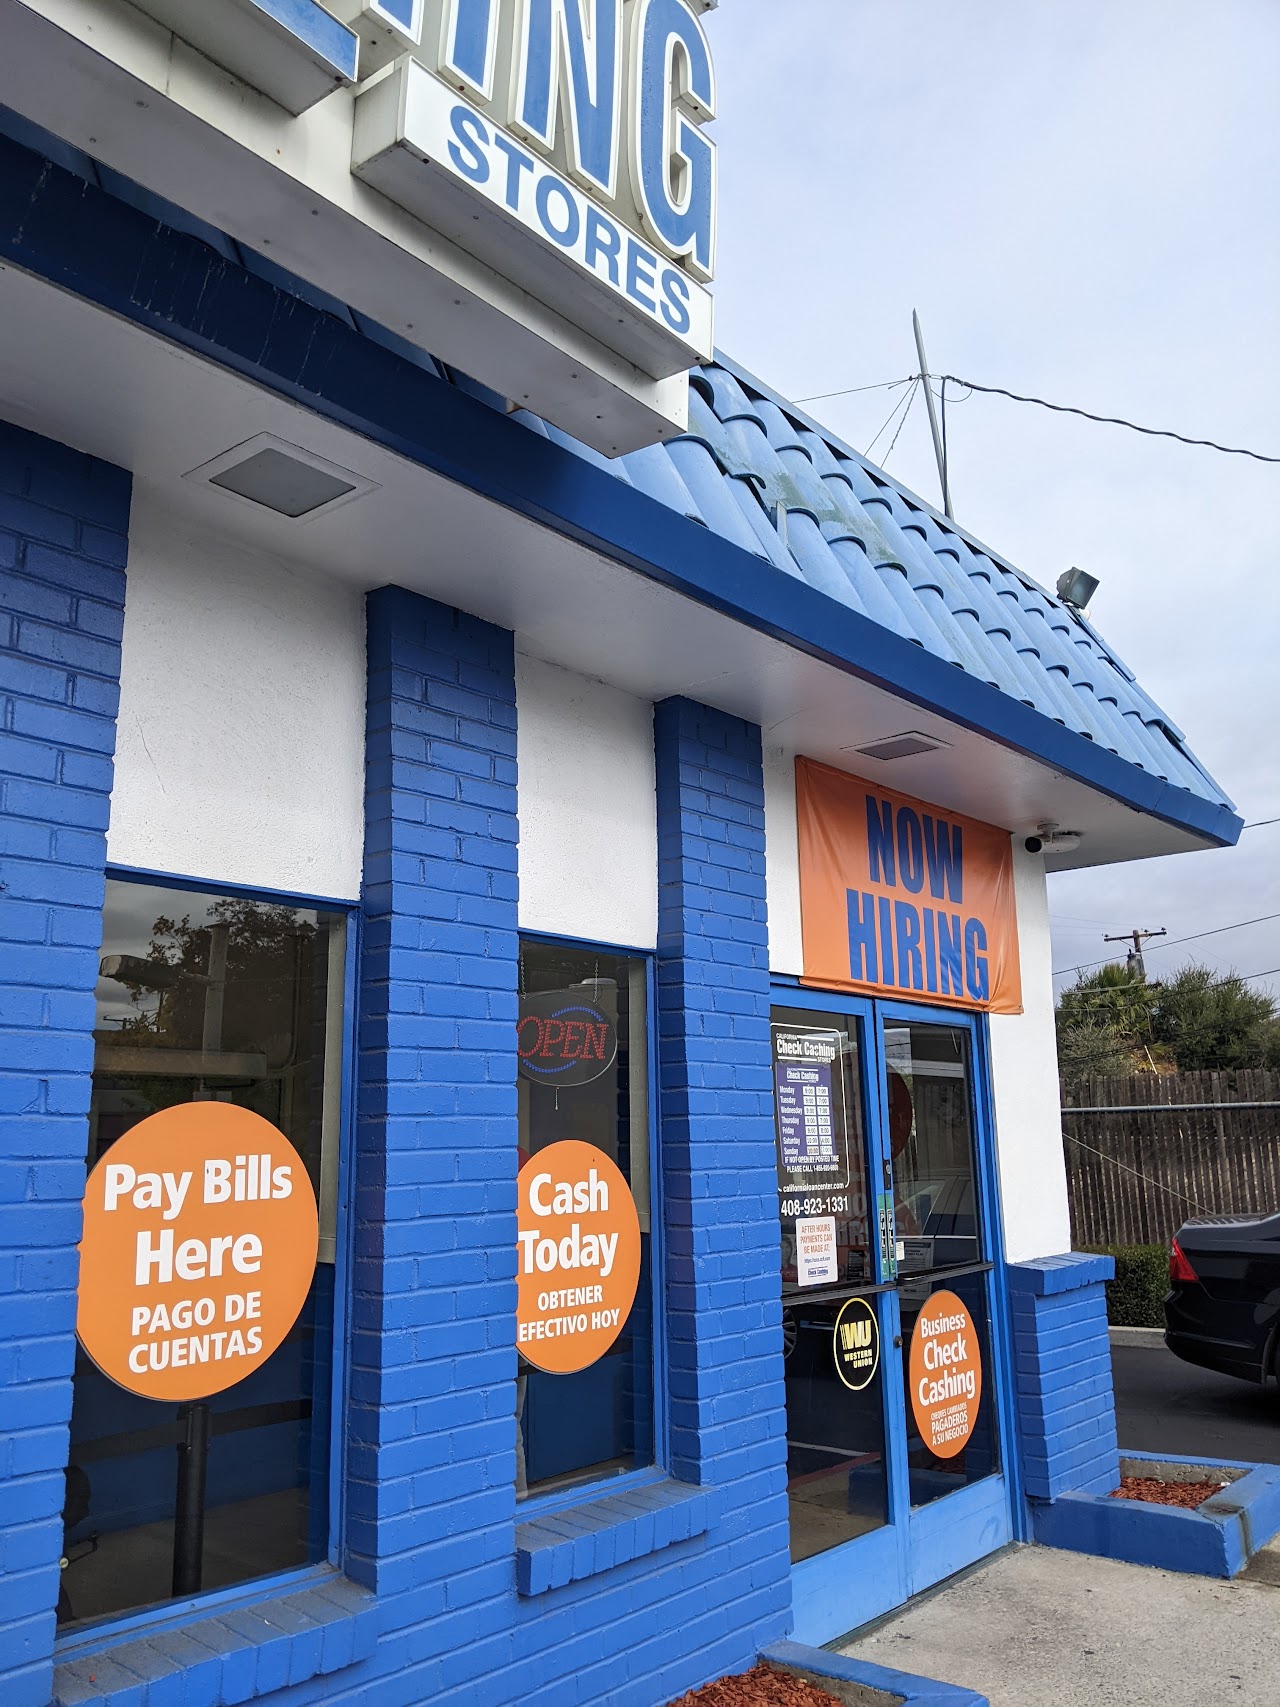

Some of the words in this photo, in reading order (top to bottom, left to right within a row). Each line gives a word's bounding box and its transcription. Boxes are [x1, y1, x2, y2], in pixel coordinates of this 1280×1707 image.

[447, 105, 690, 334] STORES
[865, 795, 963, 904] NOW
[846, 888, 989, 1001] HIRING
[517, 1015, 609, 1060] OPEN
[777, 1039, 802, 1055] Check
[780, 1086, 795, 1095] Monday
[780, 1096, 796, 1105] Tuesday
[781, 1106, 803, 1115] Wednesday
[781, 1116, 799, 1125] Thursday
[782, 1126, 795, 1135] Friday
[783, 1136, 800, 1146] Saturday
[784, 1147, 799, 1156] Sunday
[784, 1156, 789, 1164] IF
[816, 1155, 830, 1163] POSTED
[830, 1154, 840, 1162] TIME
[786, 1165, 802, 1173] PLEASE
[104, 1164, 193, 1220] Pay
[203, 1154, 293, 1204] Bills
[529, 1168, 608, 1217] Cash
[783, 1182, 845, 1192] californialoancenter.com
[781, 1196, 848, 1216] 408-923-1331
[800, 1234, 823, 1243] PAYMENTS
[823, 1233, 833, 1242] CAN
[801, 1225, 816, 1233] AFTER
[816, 1223, 831, 1232] HOURS
[135, 1229, 263, 1286] Here
[518, 1223, 619, 1277] Today
[803, 1245, 810, 1253] BE
[811, 1244, 823, 1253] MADE
[537, 1285, 603, 1312] OBTENER
[131, 1298, 216, 1336] PAGO
[224, 1291, 262, 1322] DE
[519, 1312, 588, 1342] EFECTIVO
[591, 1308, 620, 1330] HOY
[840, 1320, 872, 1350] WU
[921, 1312, 966, 1338] Business
[128, 1326, 263, 1374] CUENTAS
[843, 1349, 873, 1362] WESTERN
[924, 1333, 967, 1370] Check
[853, 1357, 873, 1369] UNION
[919, 1367, 975, 1406] Cashing
[930, 1408, 947, 1421] CHEQUES
[946, 1401, 967, 1416] CAMBIADOS
[931, 1410, 968, 1434] PAGADEROS
[932, 1435, 938, 1447] A
[937, 1432, 945, 1445] SU
[944, 1422, 969, 1441] NEGOCIO
